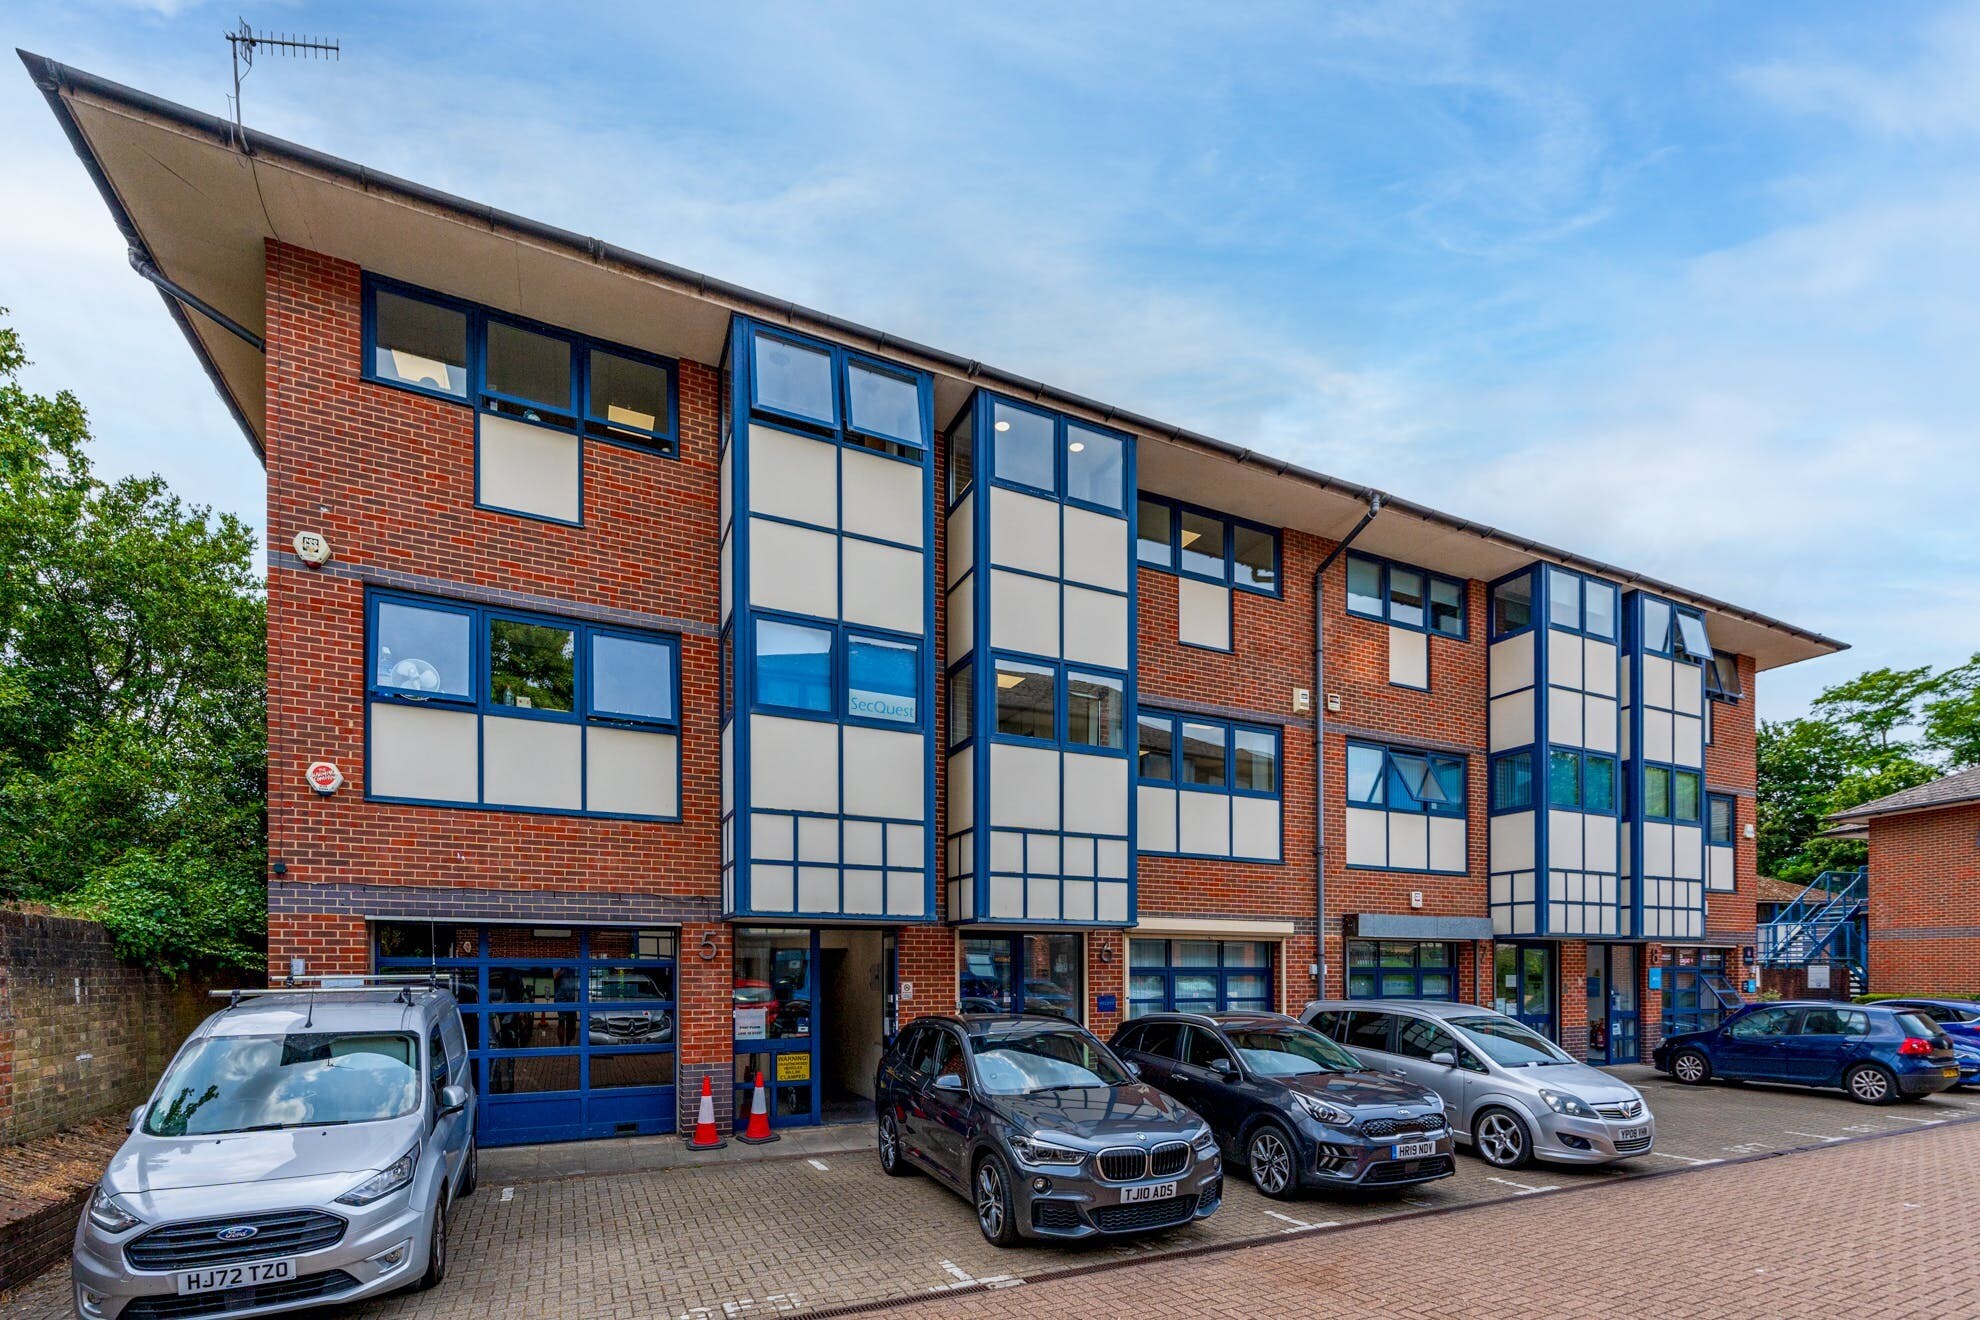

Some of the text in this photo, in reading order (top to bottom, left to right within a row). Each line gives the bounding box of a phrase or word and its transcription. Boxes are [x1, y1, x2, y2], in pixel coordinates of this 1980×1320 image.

[851, 696, 914, 717] SecQuest
[699, 931, 717, 960] 5
[1101, 941, 1113, 963] 6
[1650, 947, 1659, 966] 8
[1400, 1143, 1433, 1157] HR19 NDV
[1125, 1184, 1173, 1200] TJ10 ADS
[225, 1229, 248, 1239] Ford
[187, 1268, 242, 1290] HJ72
